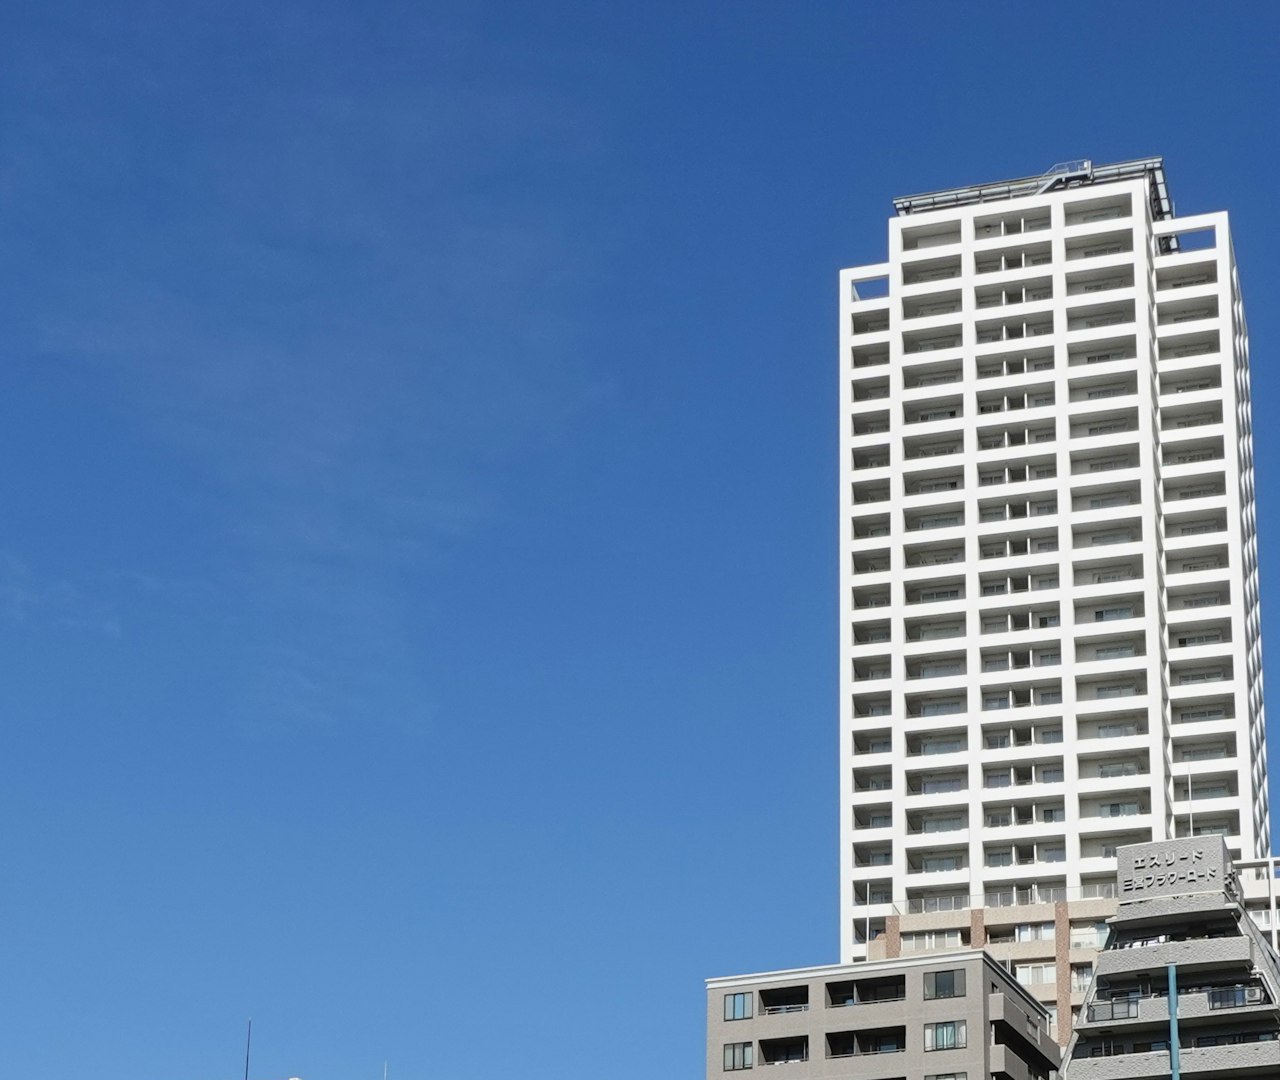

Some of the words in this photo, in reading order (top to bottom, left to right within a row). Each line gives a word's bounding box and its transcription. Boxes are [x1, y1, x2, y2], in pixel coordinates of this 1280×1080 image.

[1134, 850, 1203, 870] エスリード
[1123, 866, 1217, 892] 三宮フラワーロード
